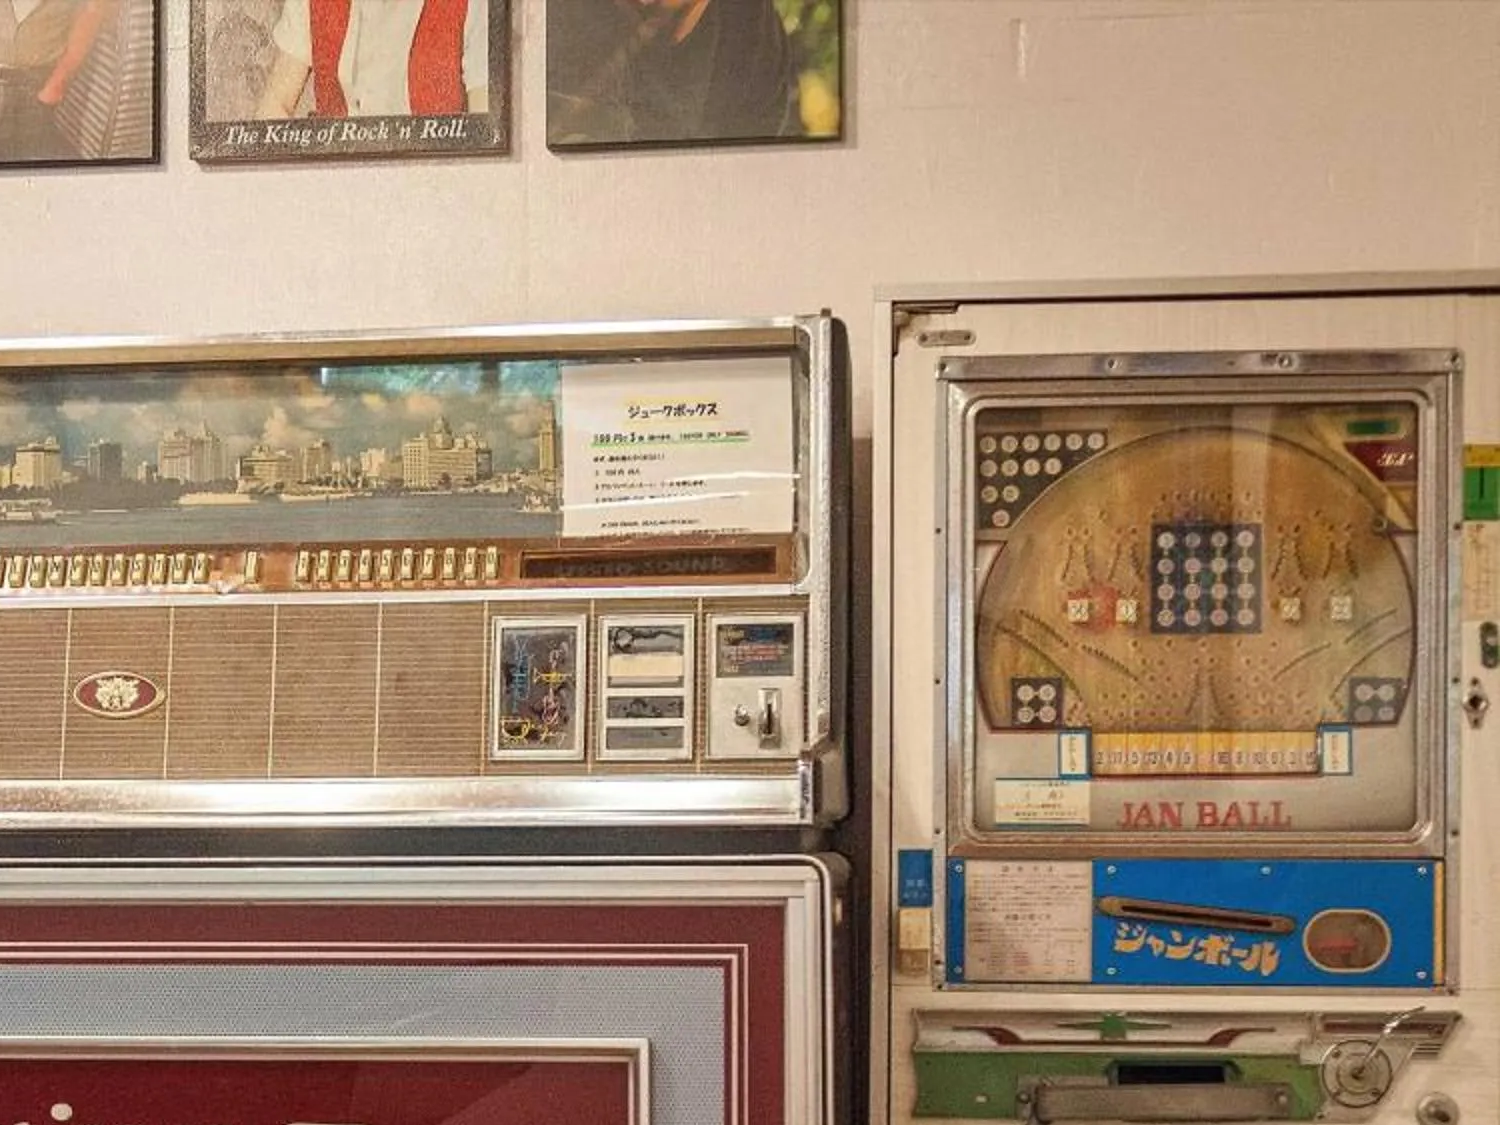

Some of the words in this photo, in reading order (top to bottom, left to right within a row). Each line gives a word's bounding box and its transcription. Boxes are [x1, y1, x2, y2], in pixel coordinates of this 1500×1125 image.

[225, 125, 259, 145] The
[263, 123, 311, 146] King
[317, 121, 337, 144] of
[340, 121, 389, 142] Rock
[420, 118, 468, 139] Roll.
[627, 402, 719, 419] ジュークボックス
[1117, 800, 1184, 829] JAN
[1196, 800, 1291, 829] BALL
[1114, 921, 1280, 976] ジャンボール
